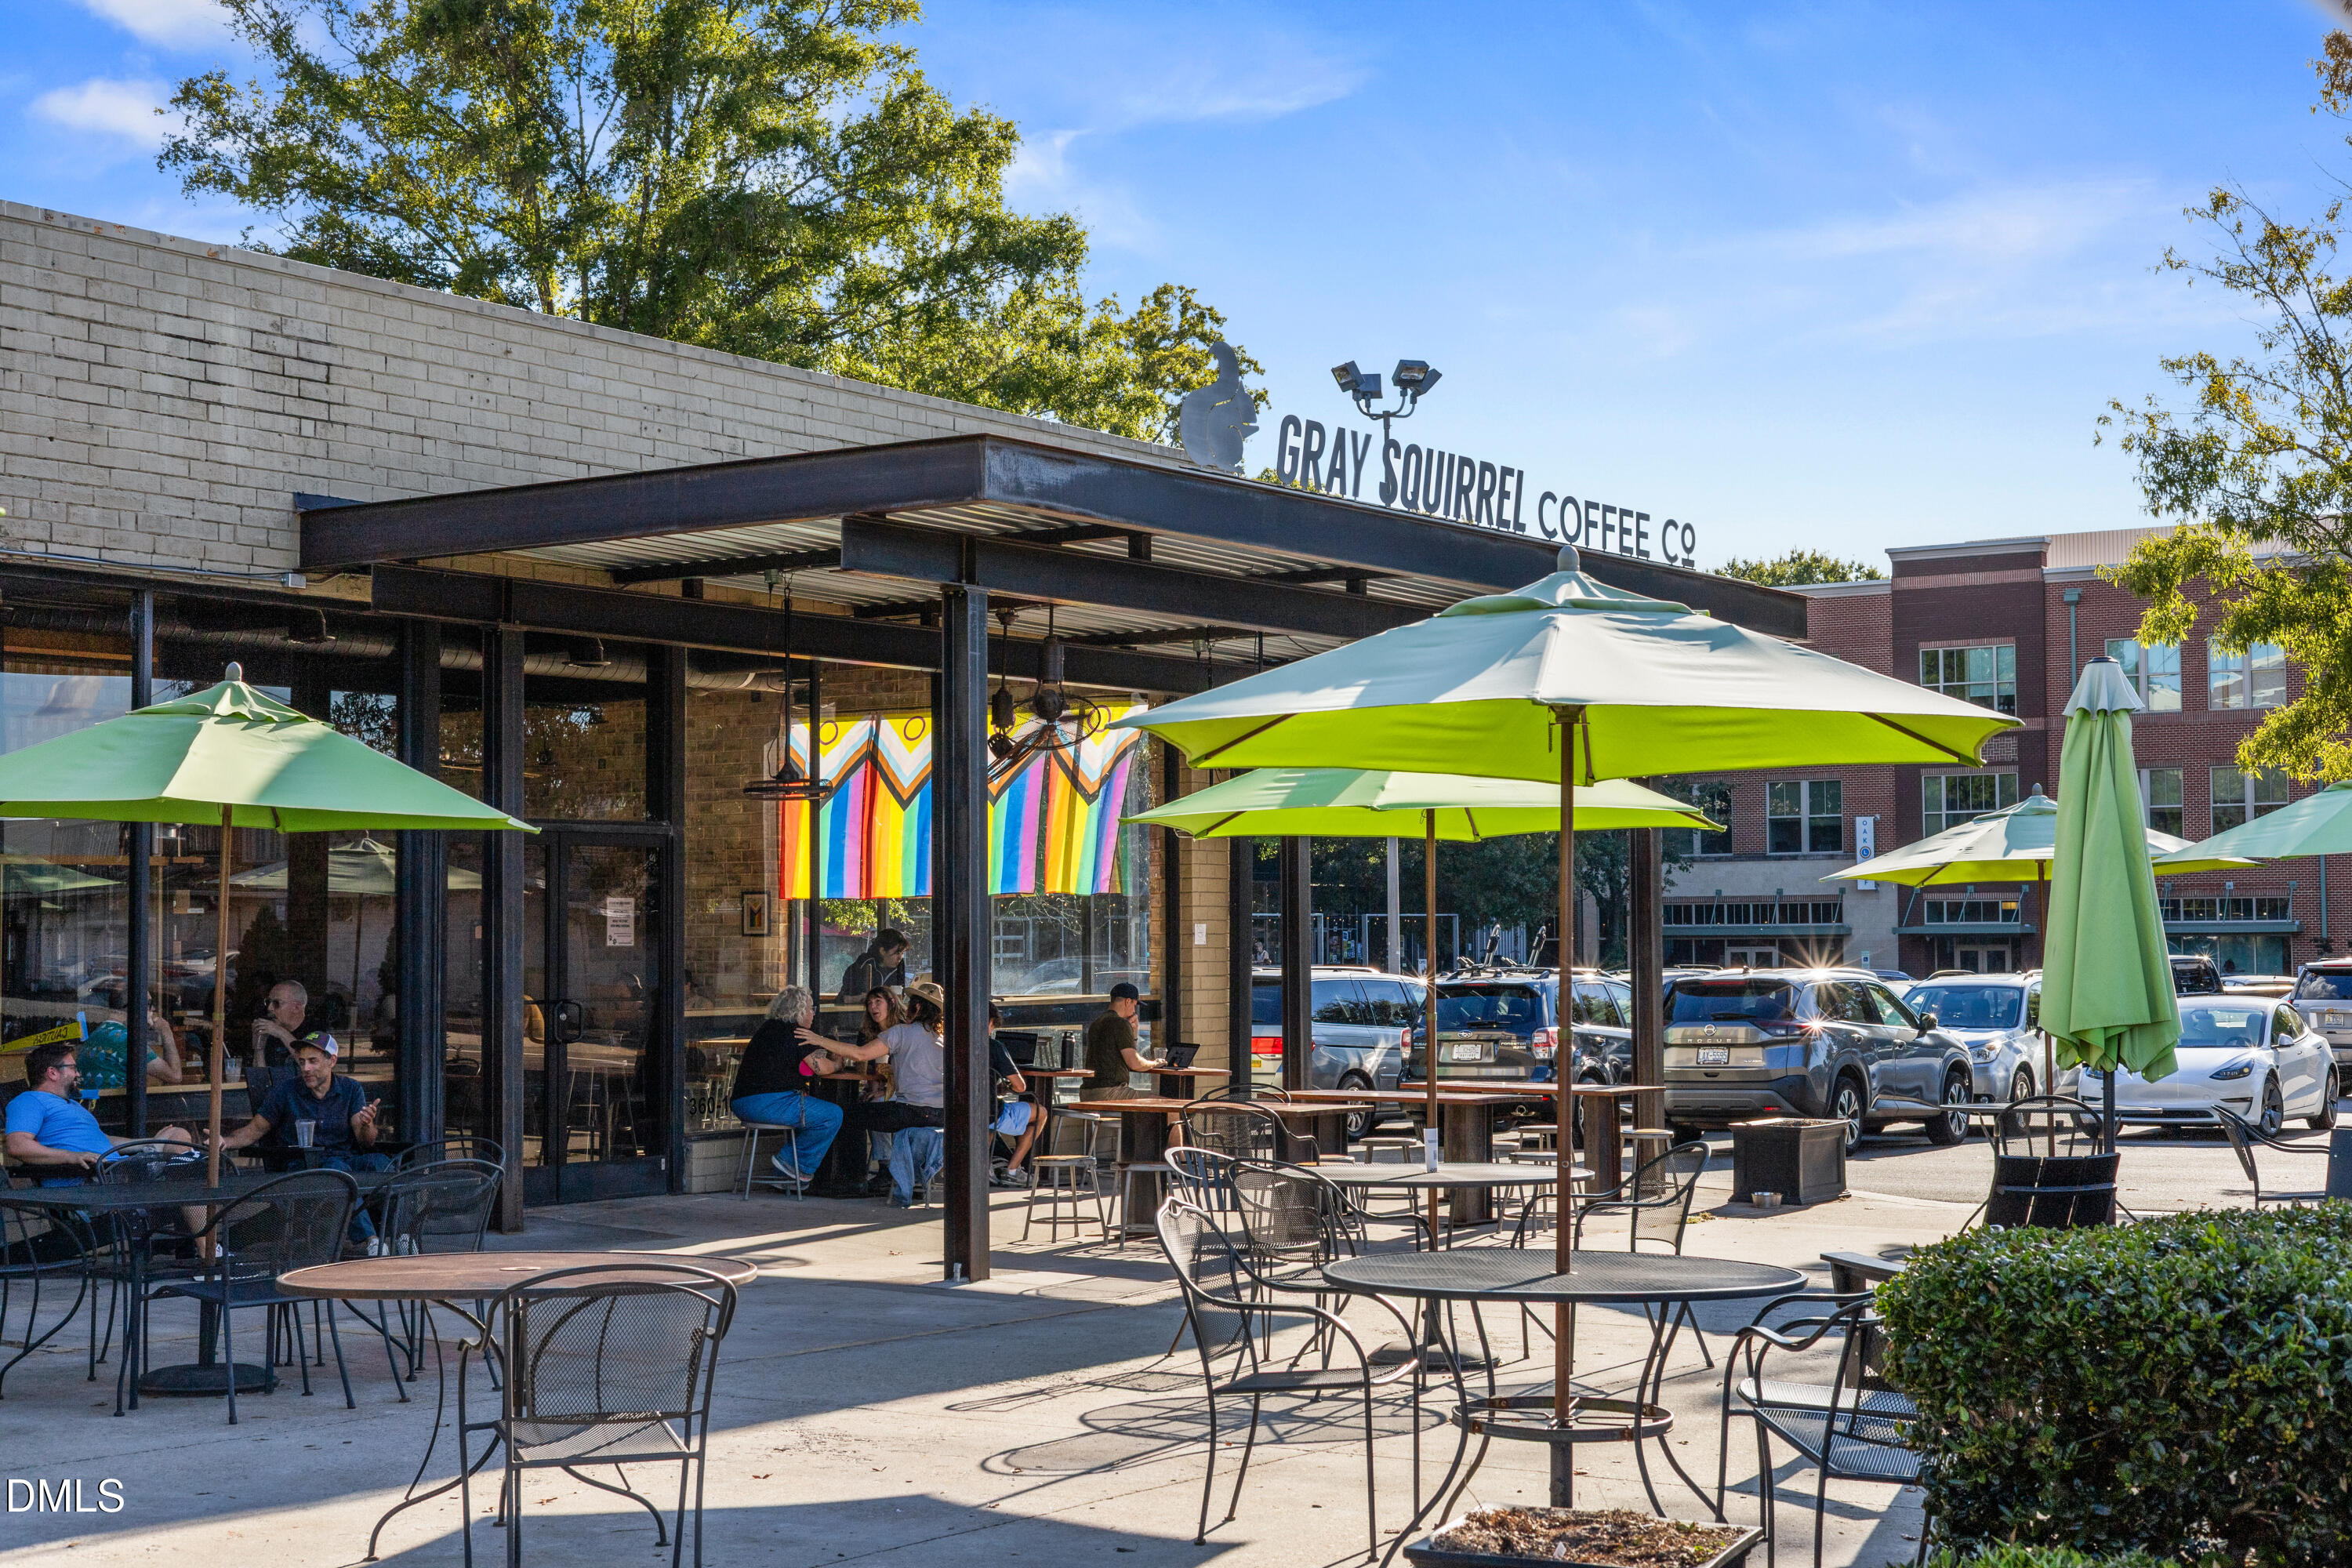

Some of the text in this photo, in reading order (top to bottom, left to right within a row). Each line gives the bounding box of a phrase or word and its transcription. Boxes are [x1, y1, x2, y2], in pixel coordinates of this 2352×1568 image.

[1277, 414, 1372, 499] GRAY
[1379, 438, 1526, 532] SQUIRREL
[1538, 491, 1650, 557] COFFEE
[689, 1094, 732, 1115] 360-1
